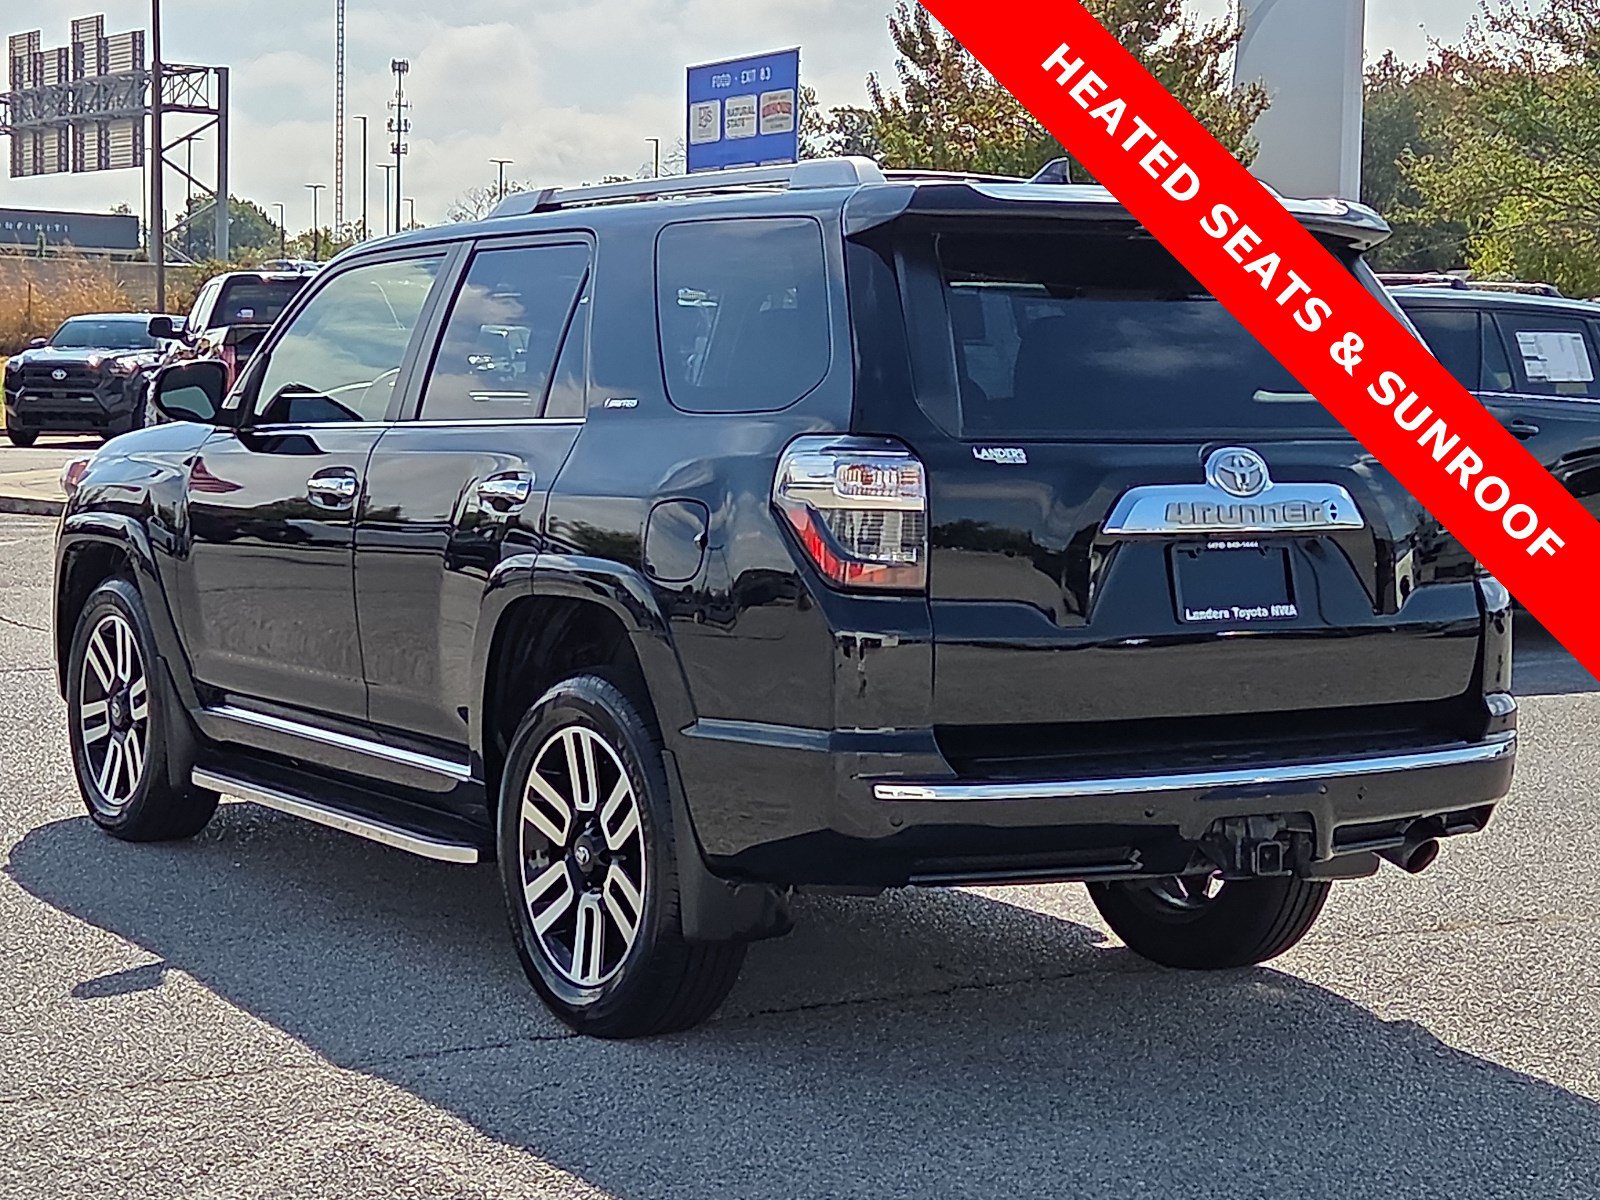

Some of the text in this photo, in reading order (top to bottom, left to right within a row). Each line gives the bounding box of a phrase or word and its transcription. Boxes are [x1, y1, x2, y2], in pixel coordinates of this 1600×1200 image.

[712, 73, 731, 88] FOOD
[1185, 607, 1231, 621] Landers
[1231, 606, 1269, 621] Toyota
